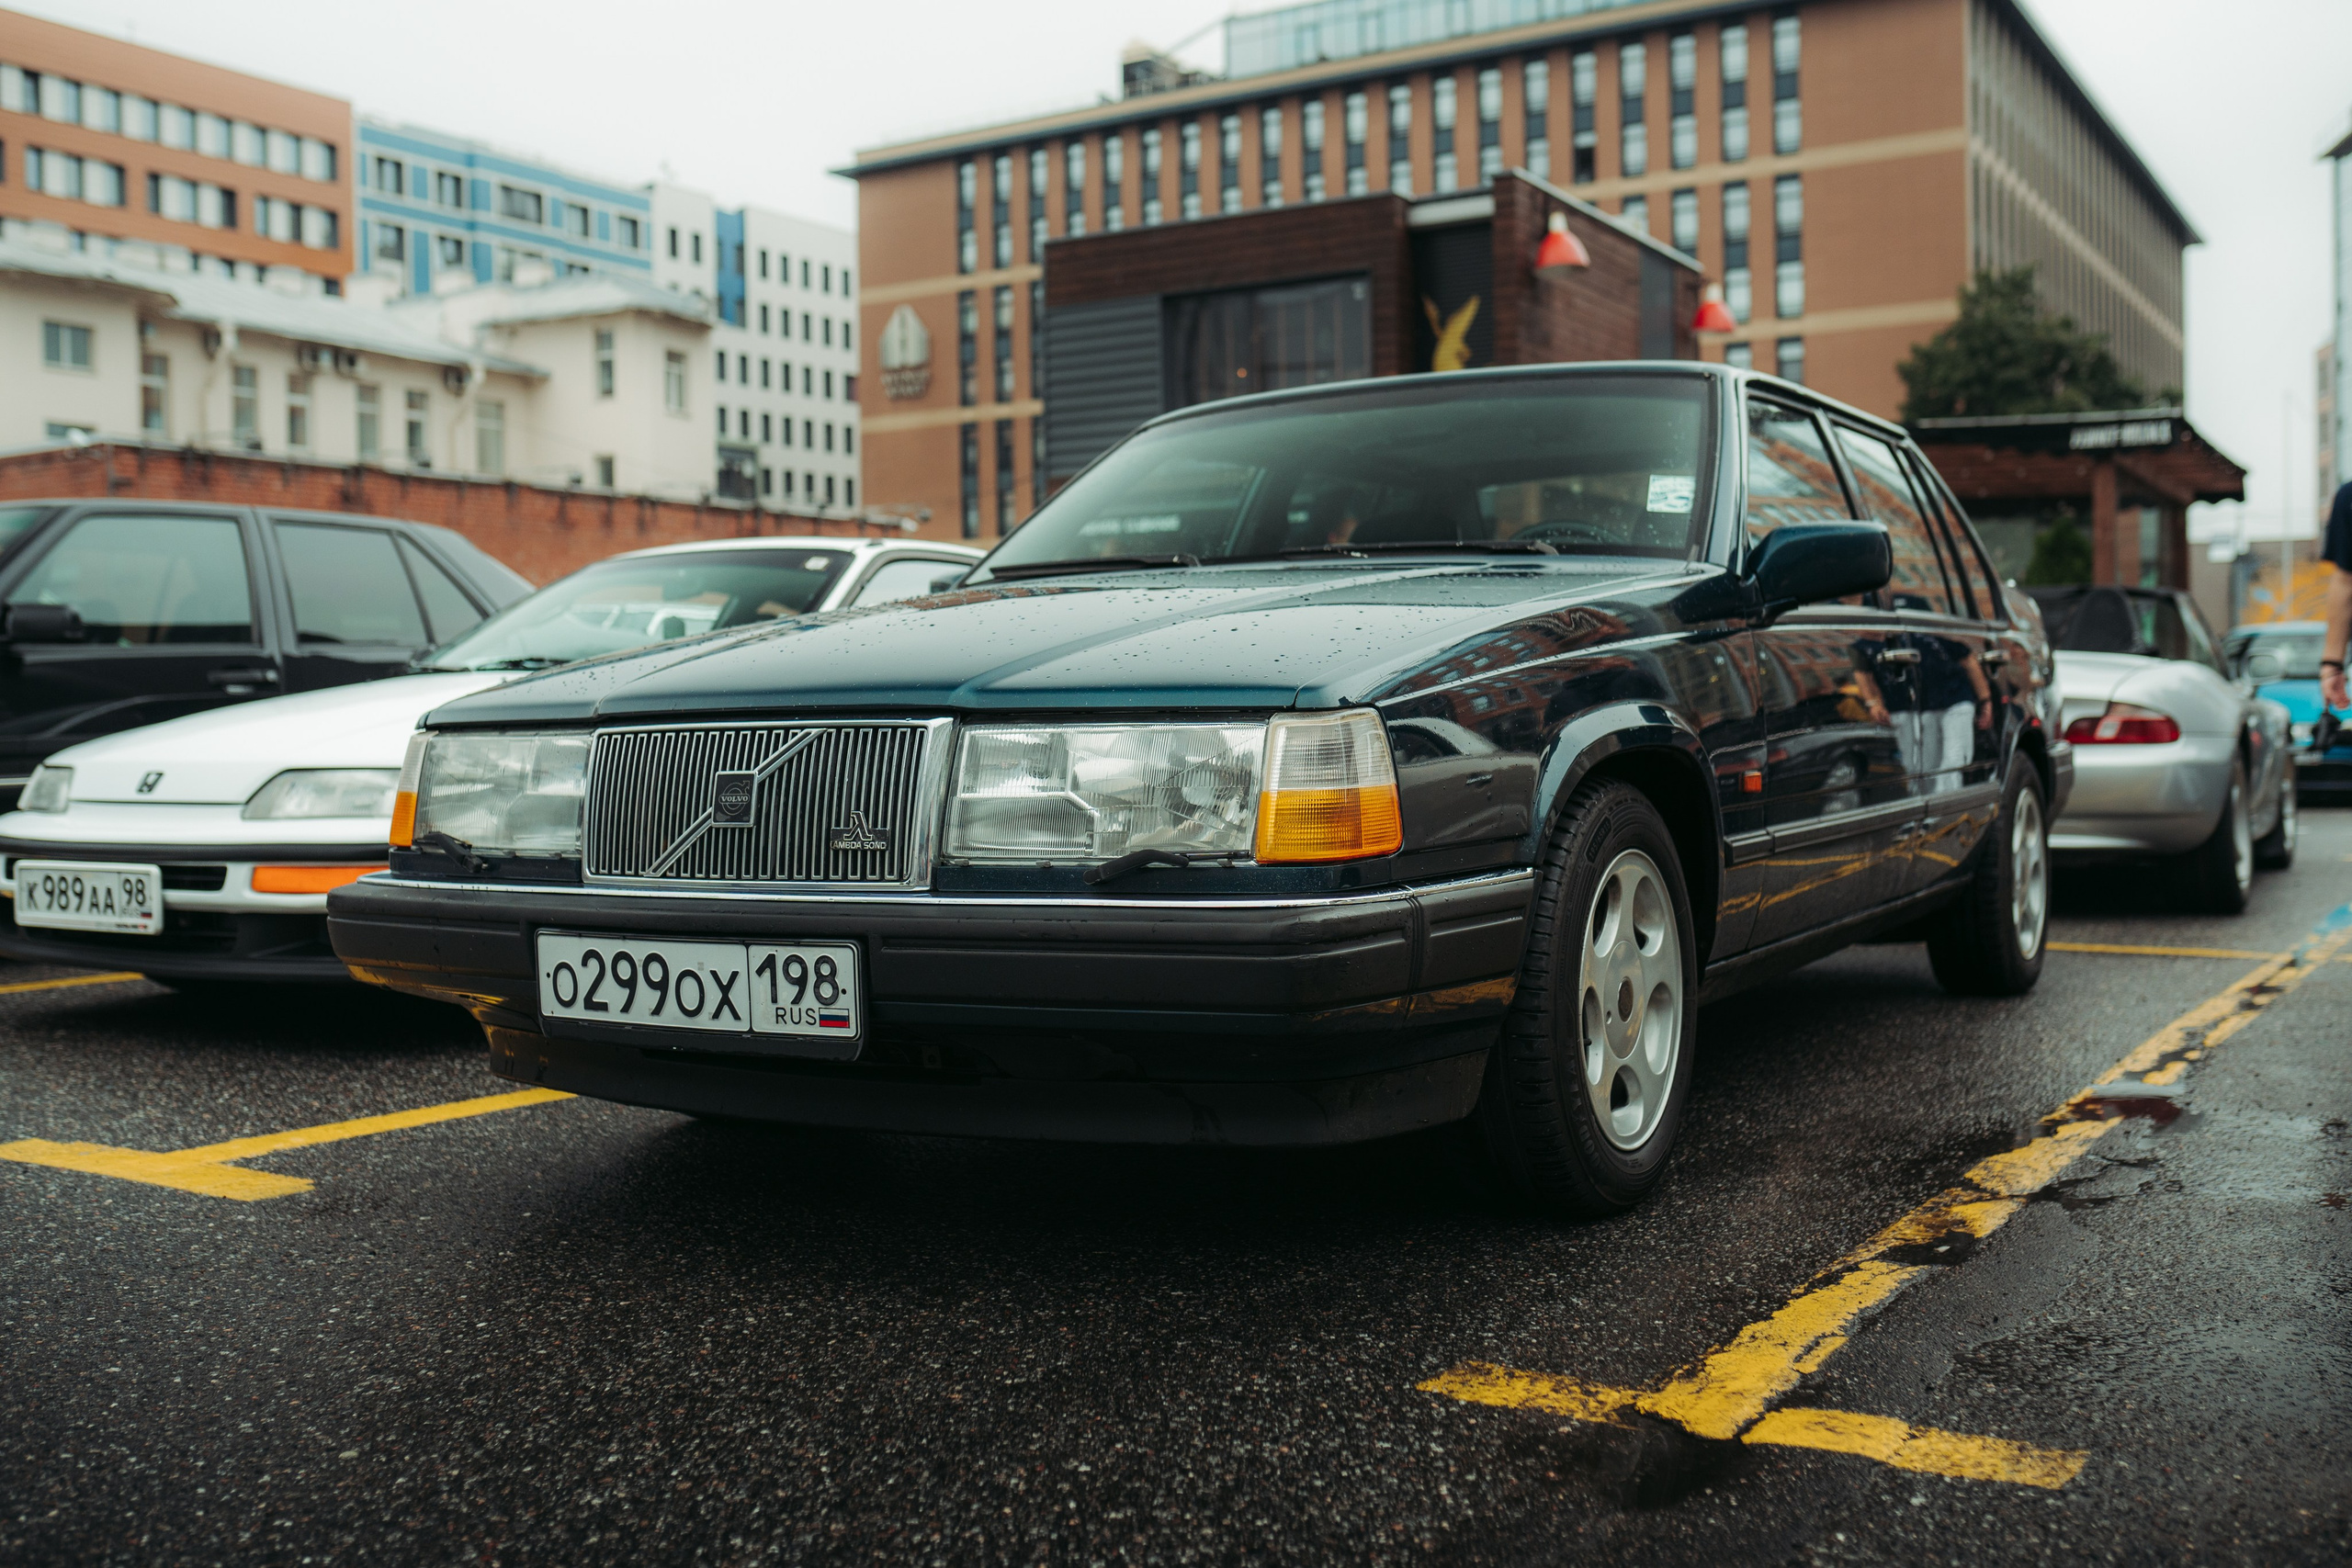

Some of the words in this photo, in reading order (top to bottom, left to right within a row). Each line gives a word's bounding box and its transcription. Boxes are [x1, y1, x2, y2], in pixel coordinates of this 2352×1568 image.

[830, 840, 862, 850] LAMBDA
[863, 840, 887, 850] SOND
[122, 877, 146, 907] 98
[755, 953, 840, 1006] 198
[775, 1007, 818, 1026] RUS
